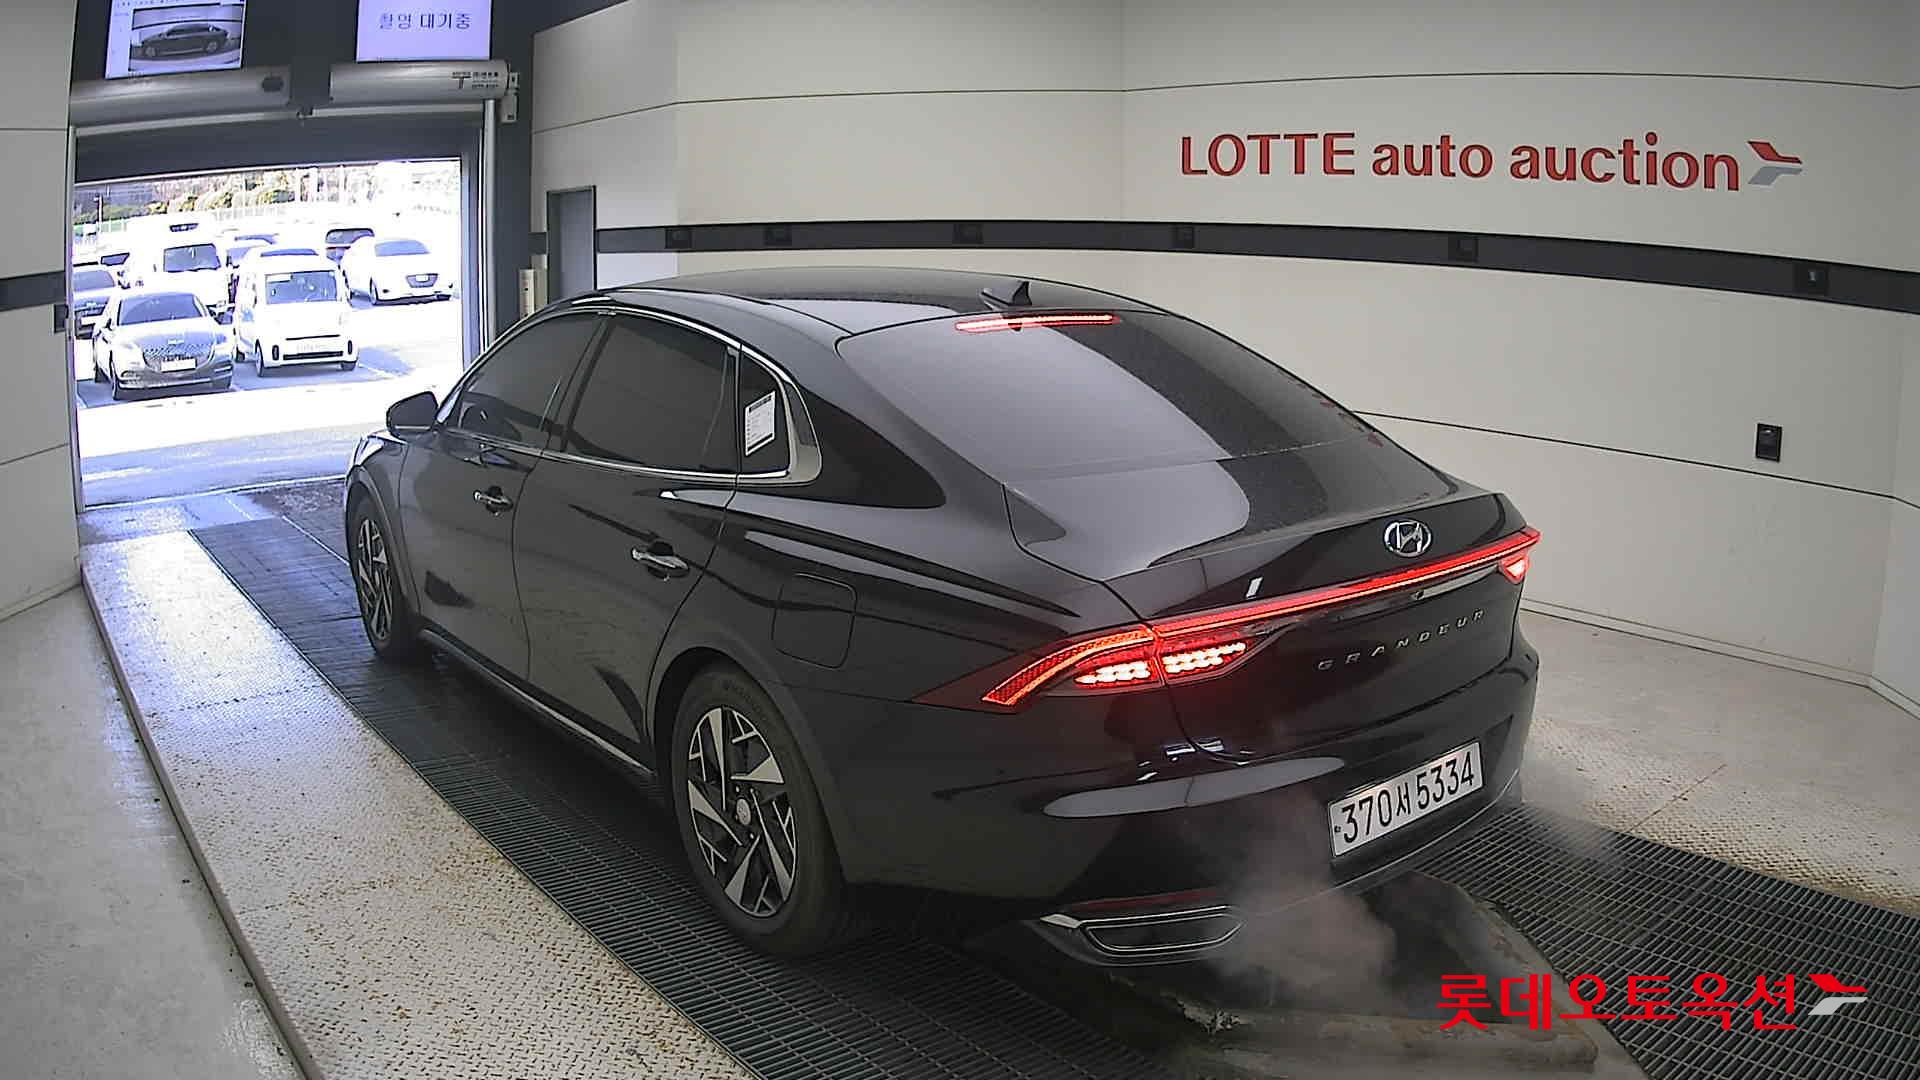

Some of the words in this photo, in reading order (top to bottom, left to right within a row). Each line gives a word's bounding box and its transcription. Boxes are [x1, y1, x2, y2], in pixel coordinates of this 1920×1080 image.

[420, 13, 473, 30] 대기중
[1181, 132, 1356, 177] LOTTE
[1371, 134, 1494, 179] auto
[1509, 131, 1740, 192] auction
[1317, 609, 1485, 671] GRANDEUR
